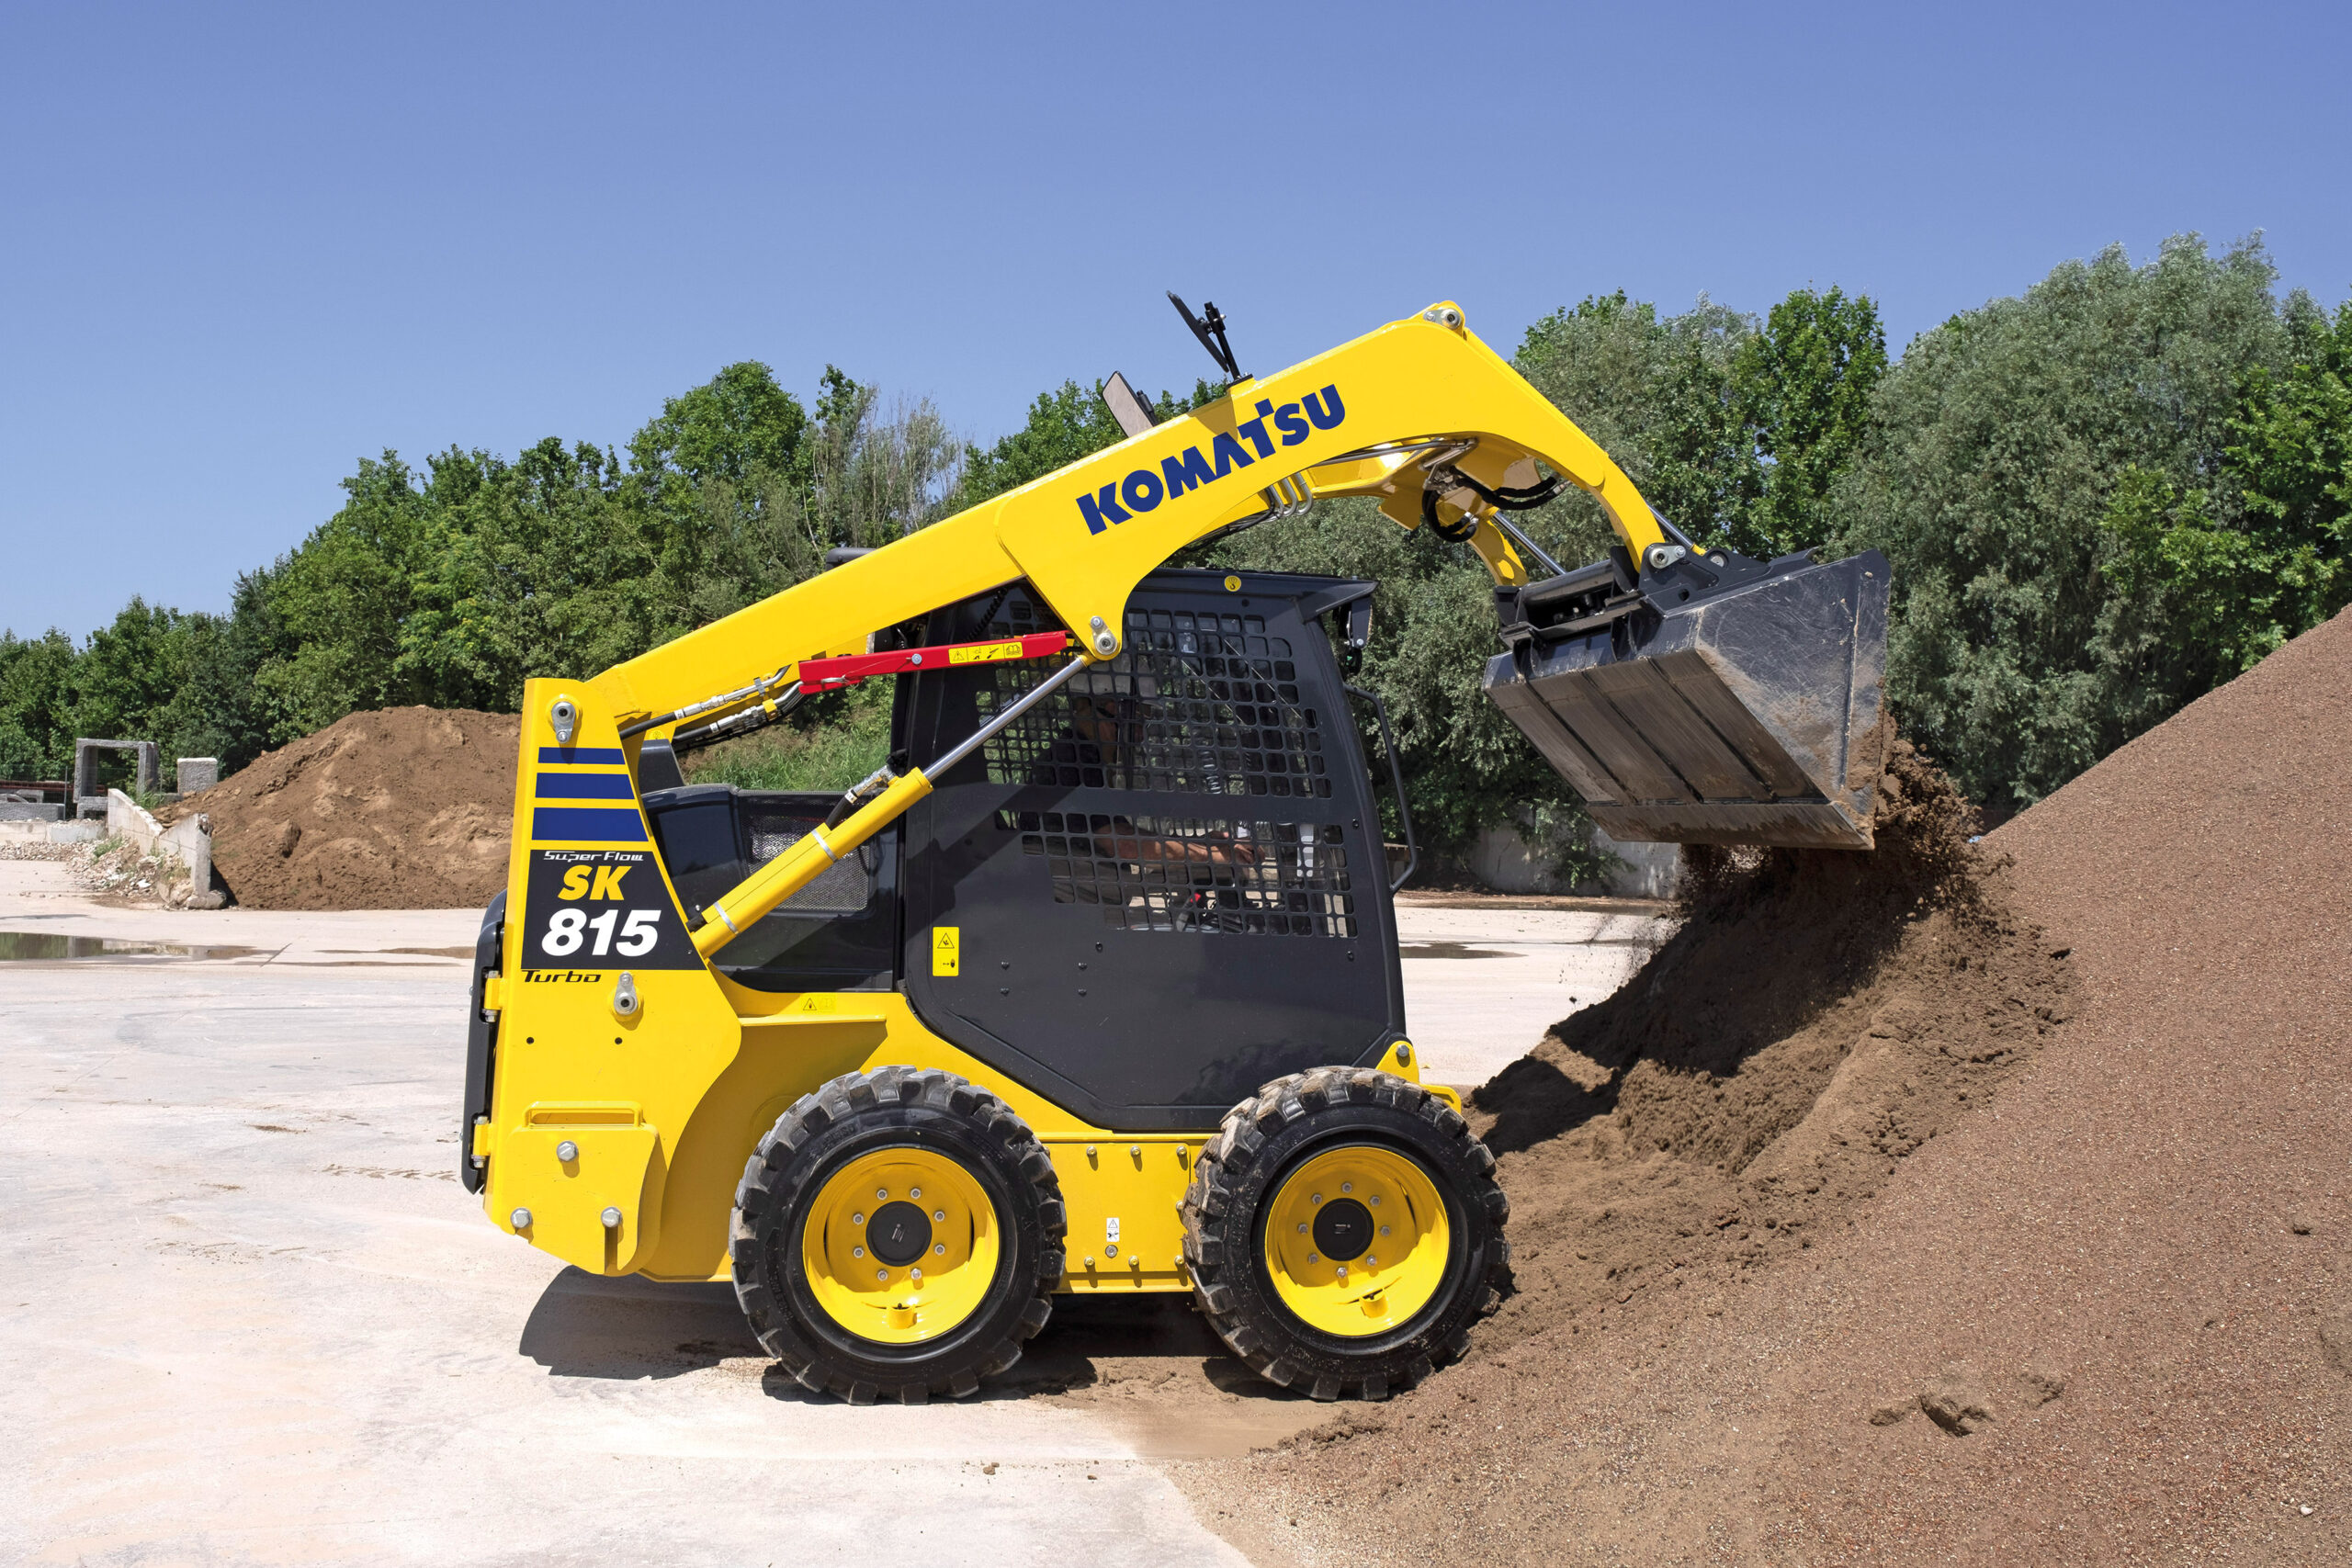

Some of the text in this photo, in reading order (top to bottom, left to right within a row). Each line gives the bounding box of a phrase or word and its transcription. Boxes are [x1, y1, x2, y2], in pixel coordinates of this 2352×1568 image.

[1075, 383, 1346, 536] KOMATSU
[557, 864, 633, 900] SK
[541, 908, 662, 956] 815
[521, 969, 602, 983] Turbo
